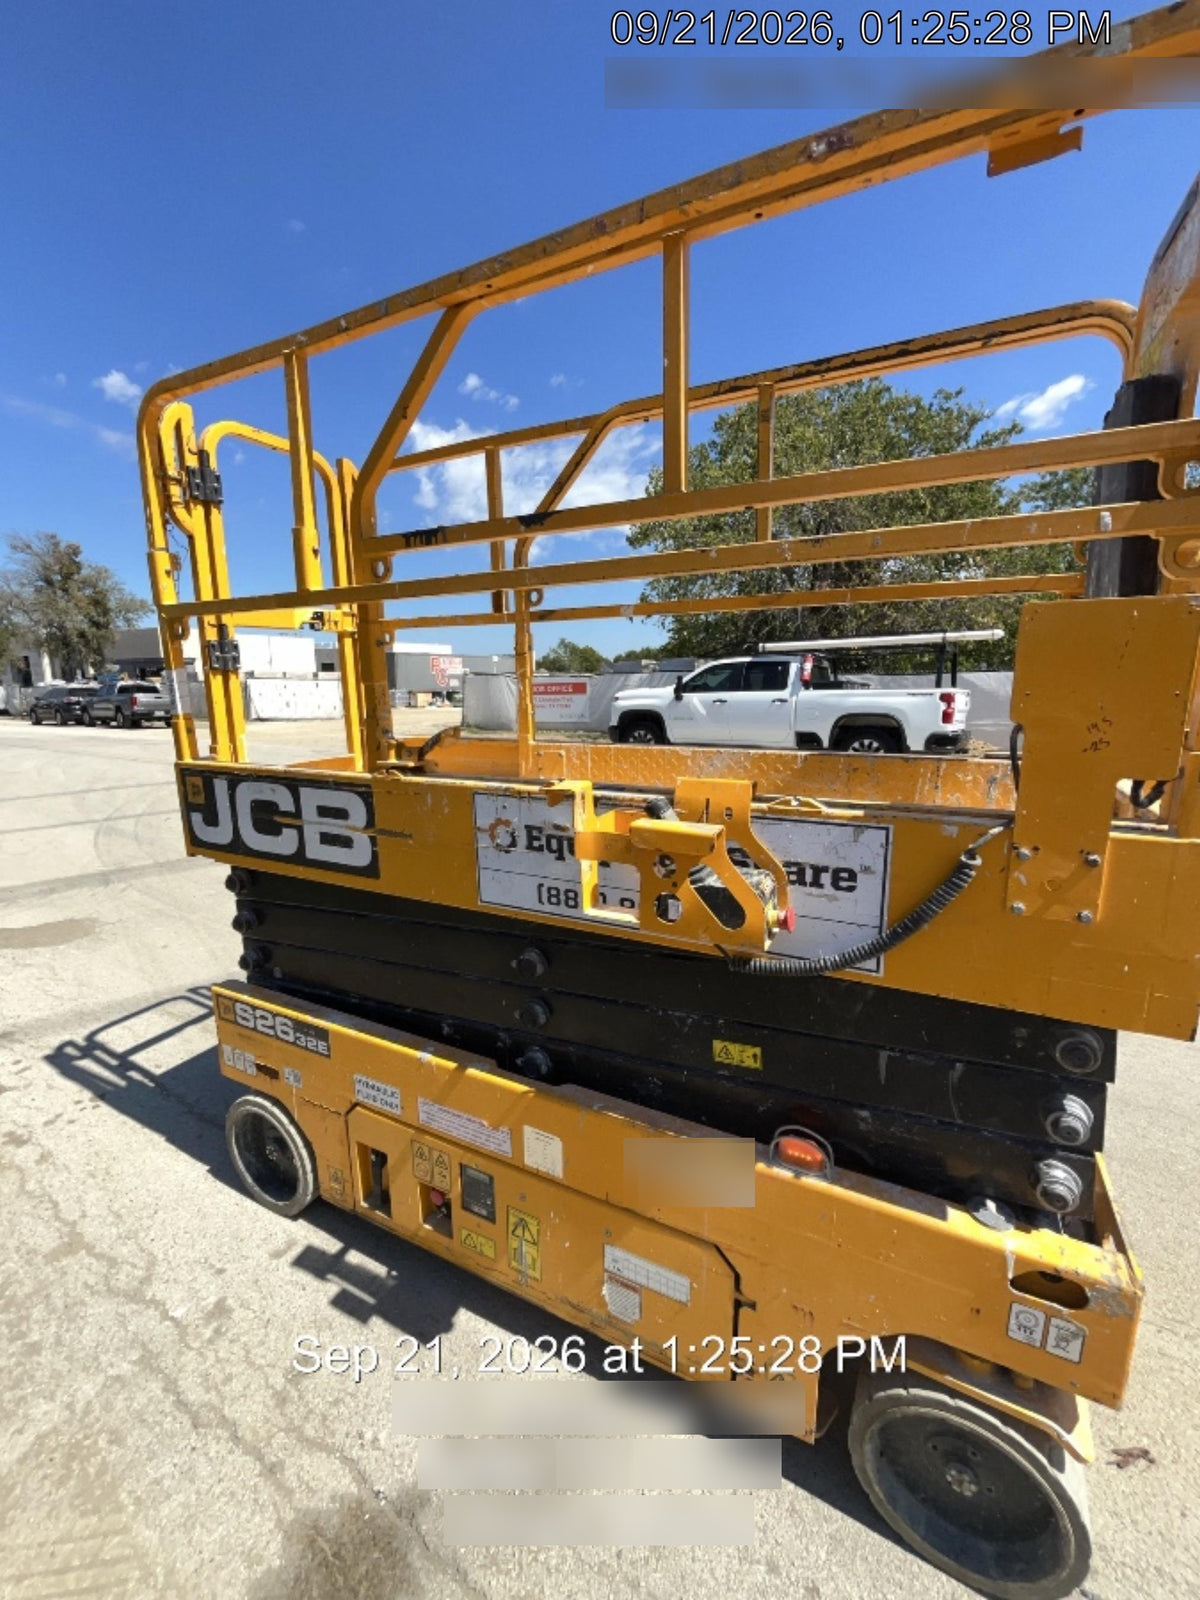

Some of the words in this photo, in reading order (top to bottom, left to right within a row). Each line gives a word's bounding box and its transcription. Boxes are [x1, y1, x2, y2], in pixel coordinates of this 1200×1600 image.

[190, 778, 373, 867] JCB
[234, 1001, 295, 1043] S26
[295, 1032, 329, 1055] 32E
